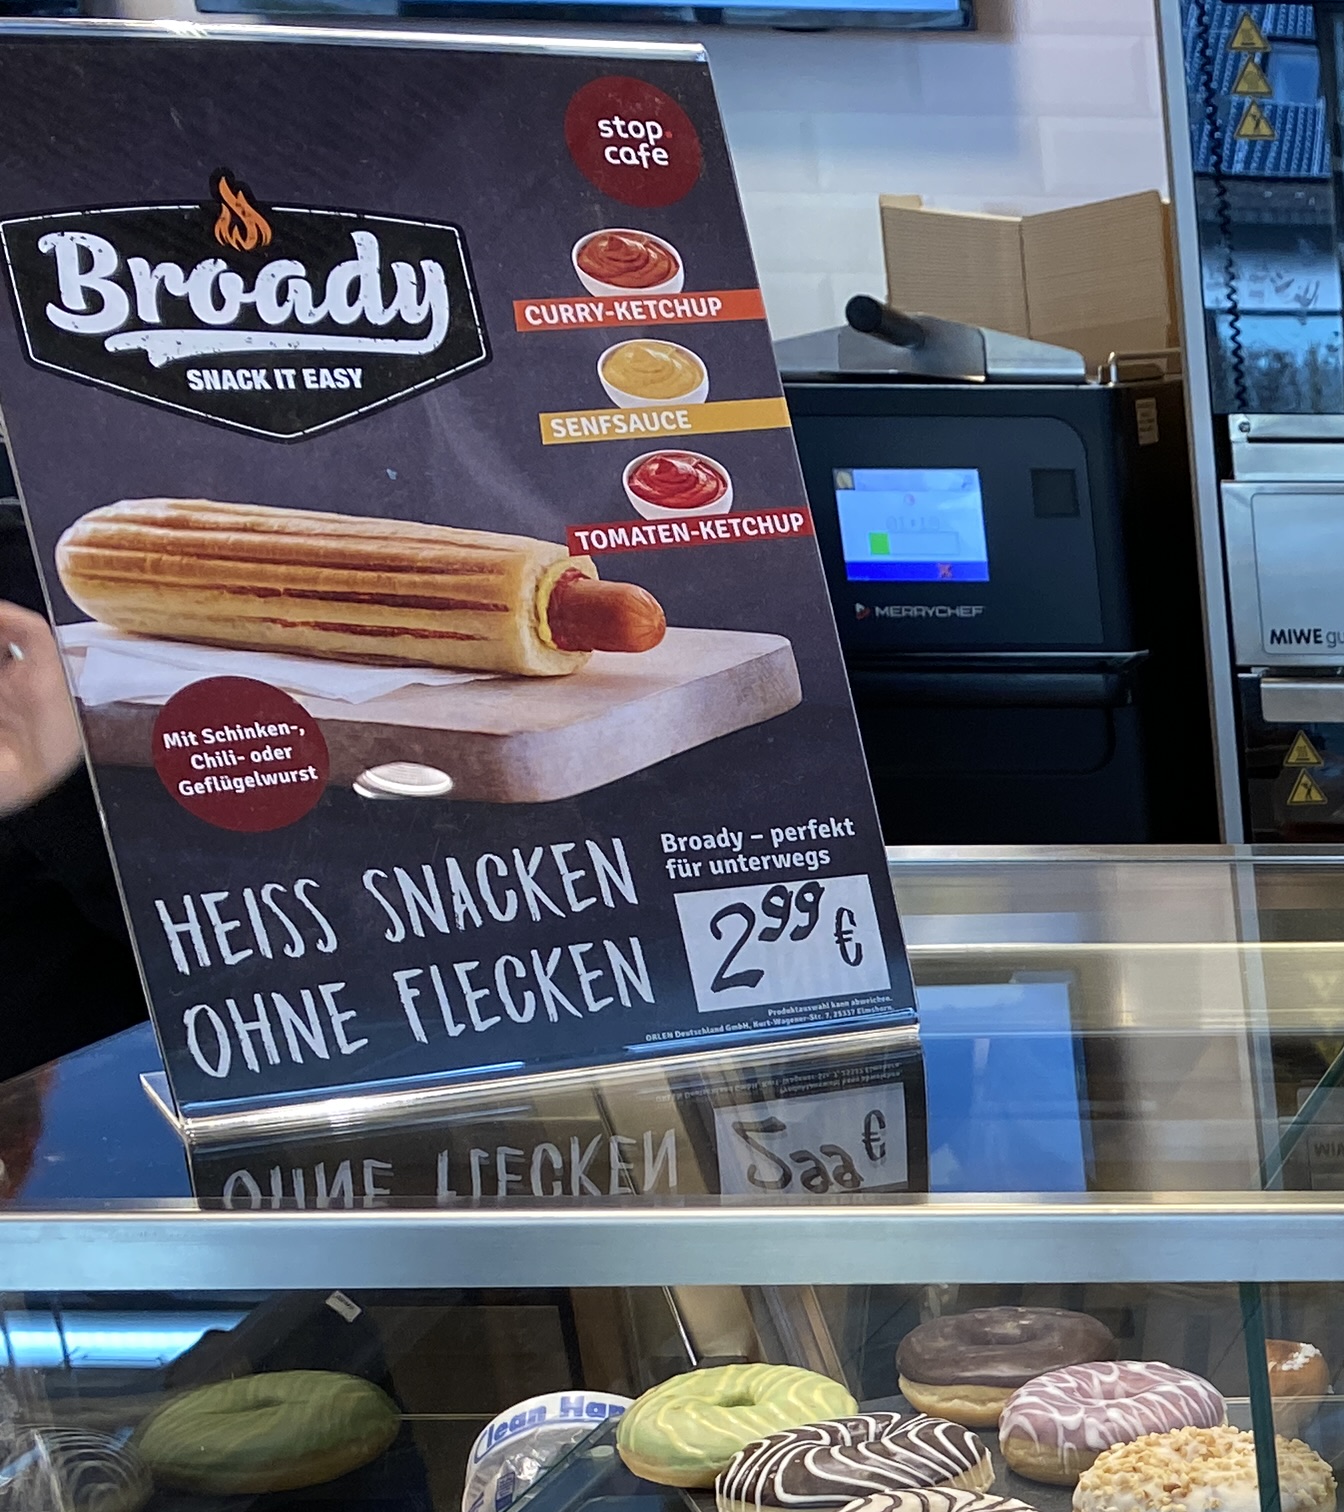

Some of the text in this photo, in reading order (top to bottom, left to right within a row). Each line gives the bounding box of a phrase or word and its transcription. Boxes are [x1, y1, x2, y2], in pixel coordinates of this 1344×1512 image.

[604, 145, 670, 169] cafe
[38, 230, 450, 362] Broady
[524, 296, 723, 327] CURRY-KETCHUP
[187, 368, 365, 391] SNACK IT EASY
[550, 410, 692, 439] SENFSAUCE
[574, 513, 805, 551] TOMATEN-KETCHUP
[874, 604, 984, 618] MERRYCHEF
[1270, 627, 1323, 645] MIWE
[163, 721, 306, 749] Mit Schinken-,
[190, 745, 293, 771] Chili- oder
[178, 765, 319, 797] Geflügelwurst
[660, 816, 856, 854] Broady perfekt
[665, 848, 832, 880] für unterwegs
[154, 837, 640, 977] HEISS SNACKEN
[183, 936, 657, 1080] OHNE FLECKEN
